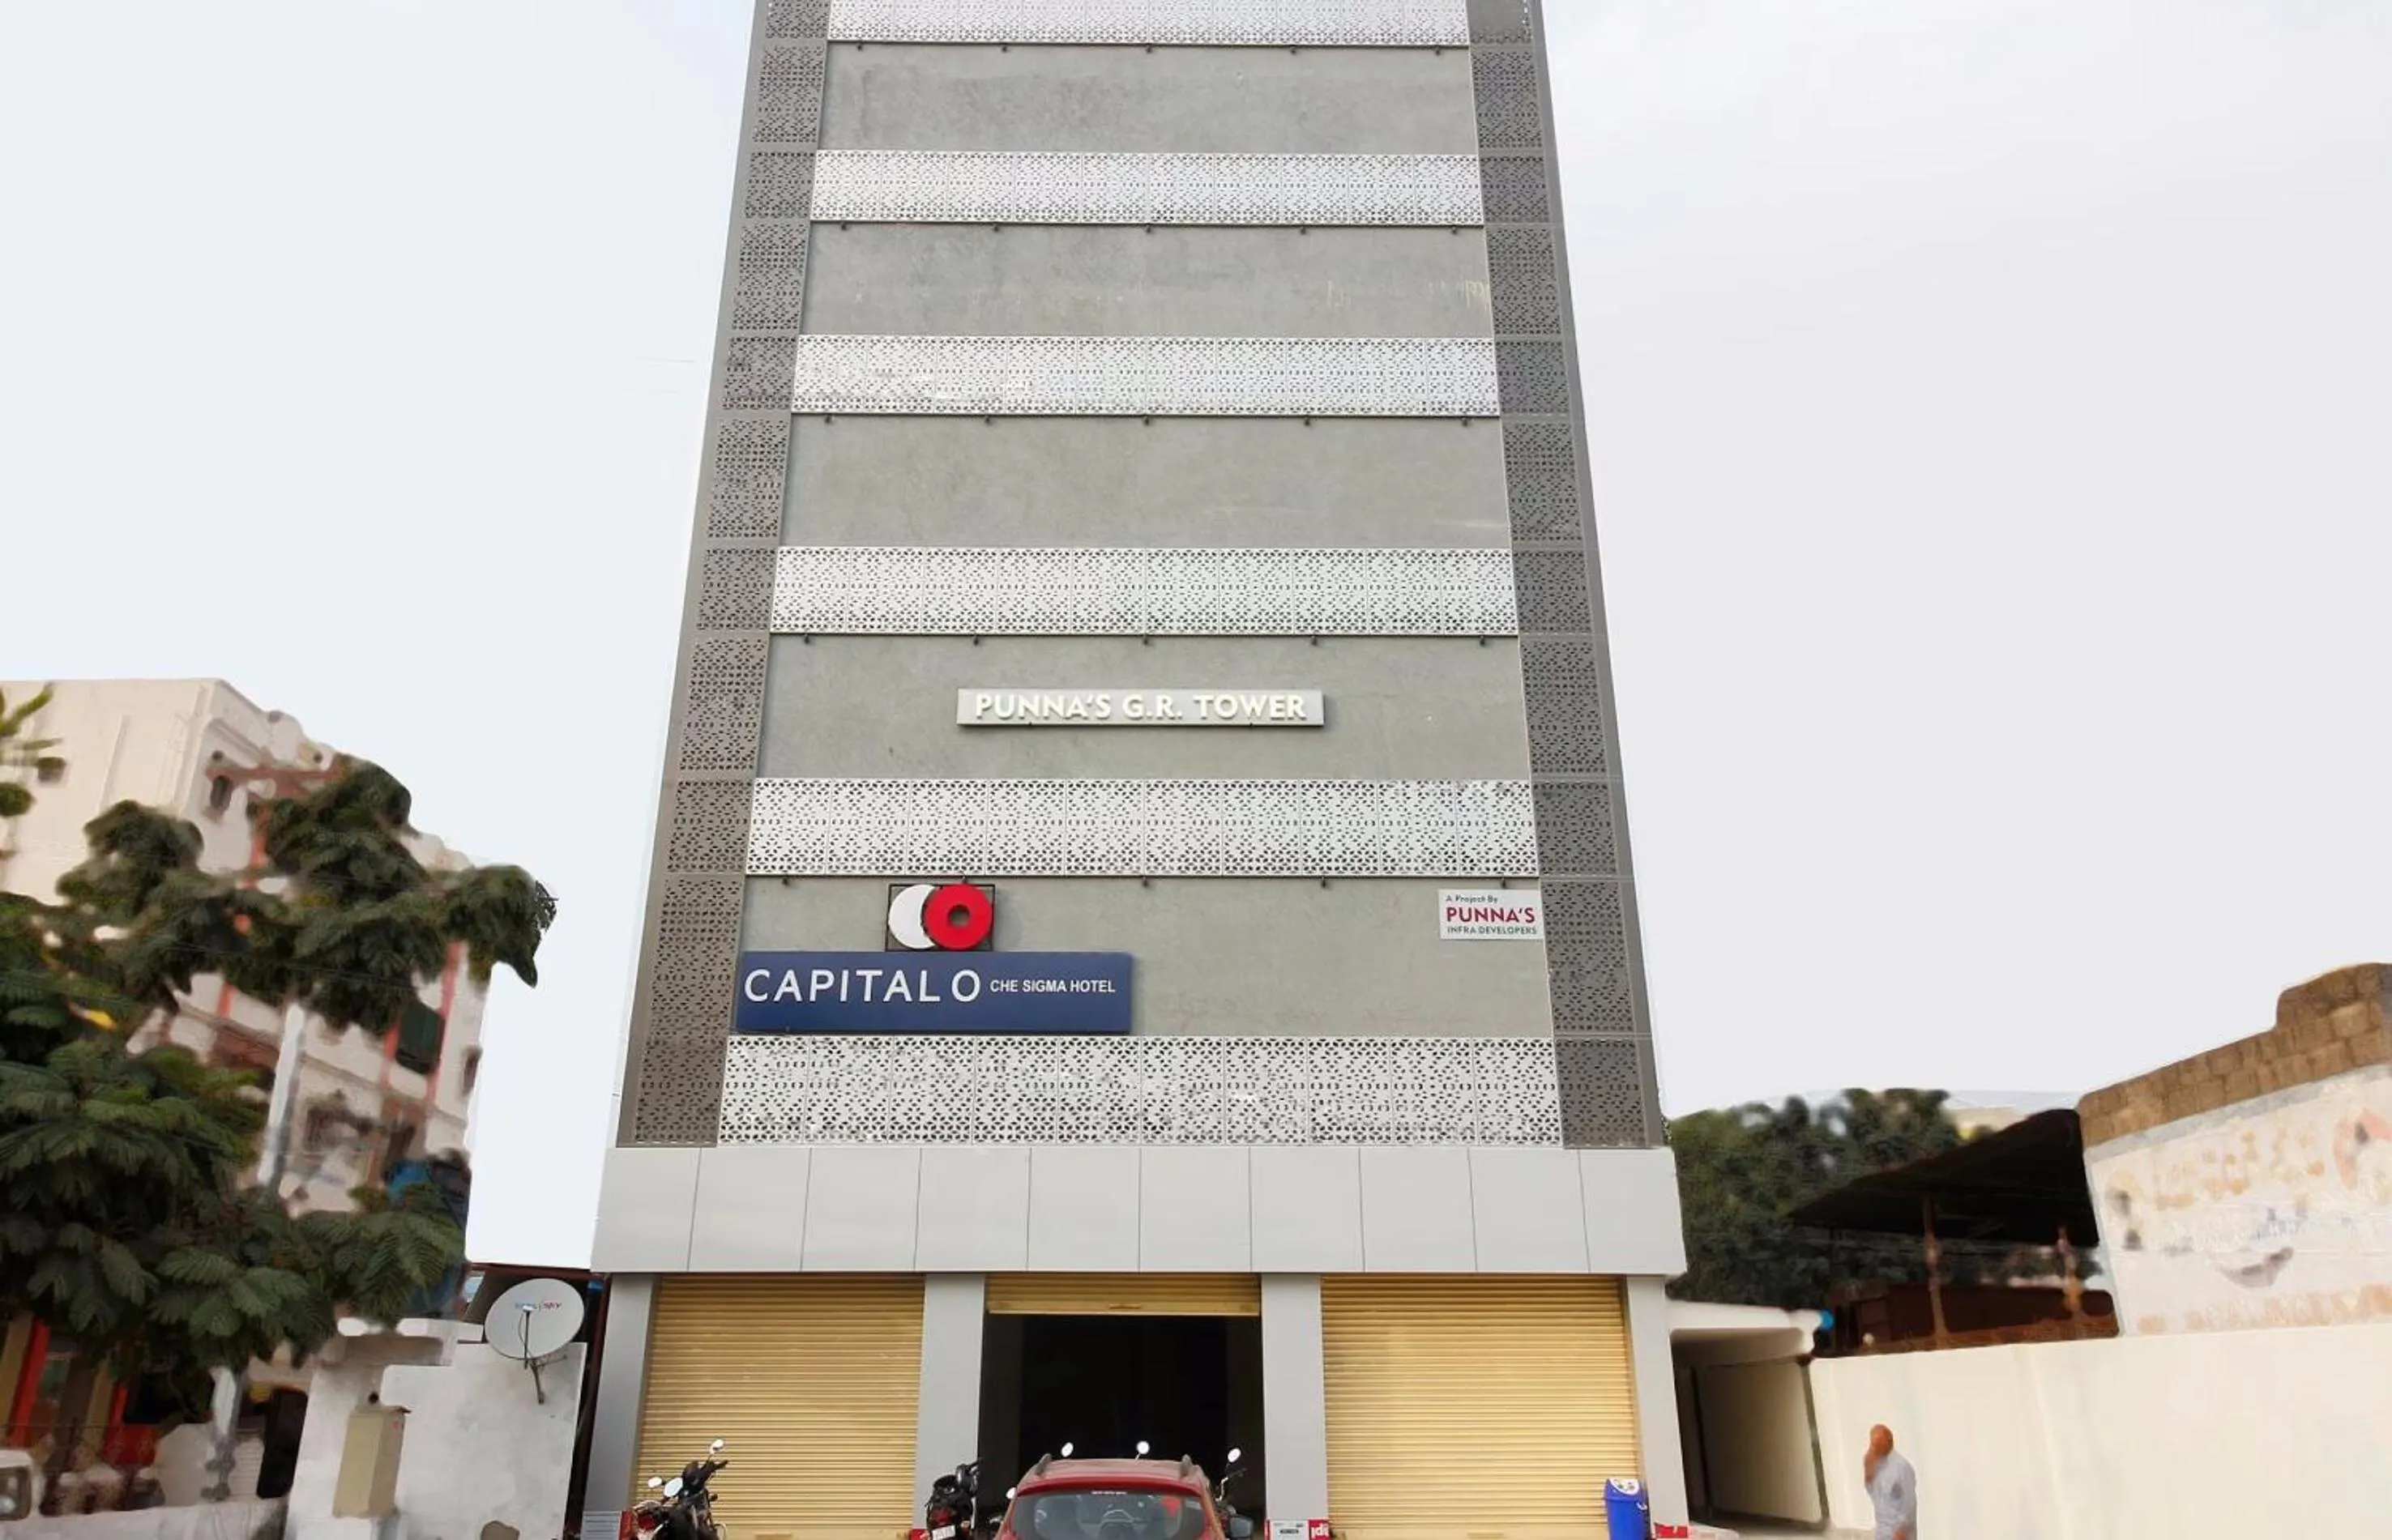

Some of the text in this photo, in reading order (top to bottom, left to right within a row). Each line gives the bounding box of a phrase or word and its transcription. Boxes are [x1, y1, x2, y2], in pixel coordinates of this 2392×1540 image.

[975, 693, 1307, 720] PUNNA'S G.R. TOWER
[1446, 907, 1536, 923] PUNNA'S
[1479, 926, 1536, 935] DEVELOPERS
[744, 970, 1116, 1002] CAPITAL O CHE SIGMA HOTEL
